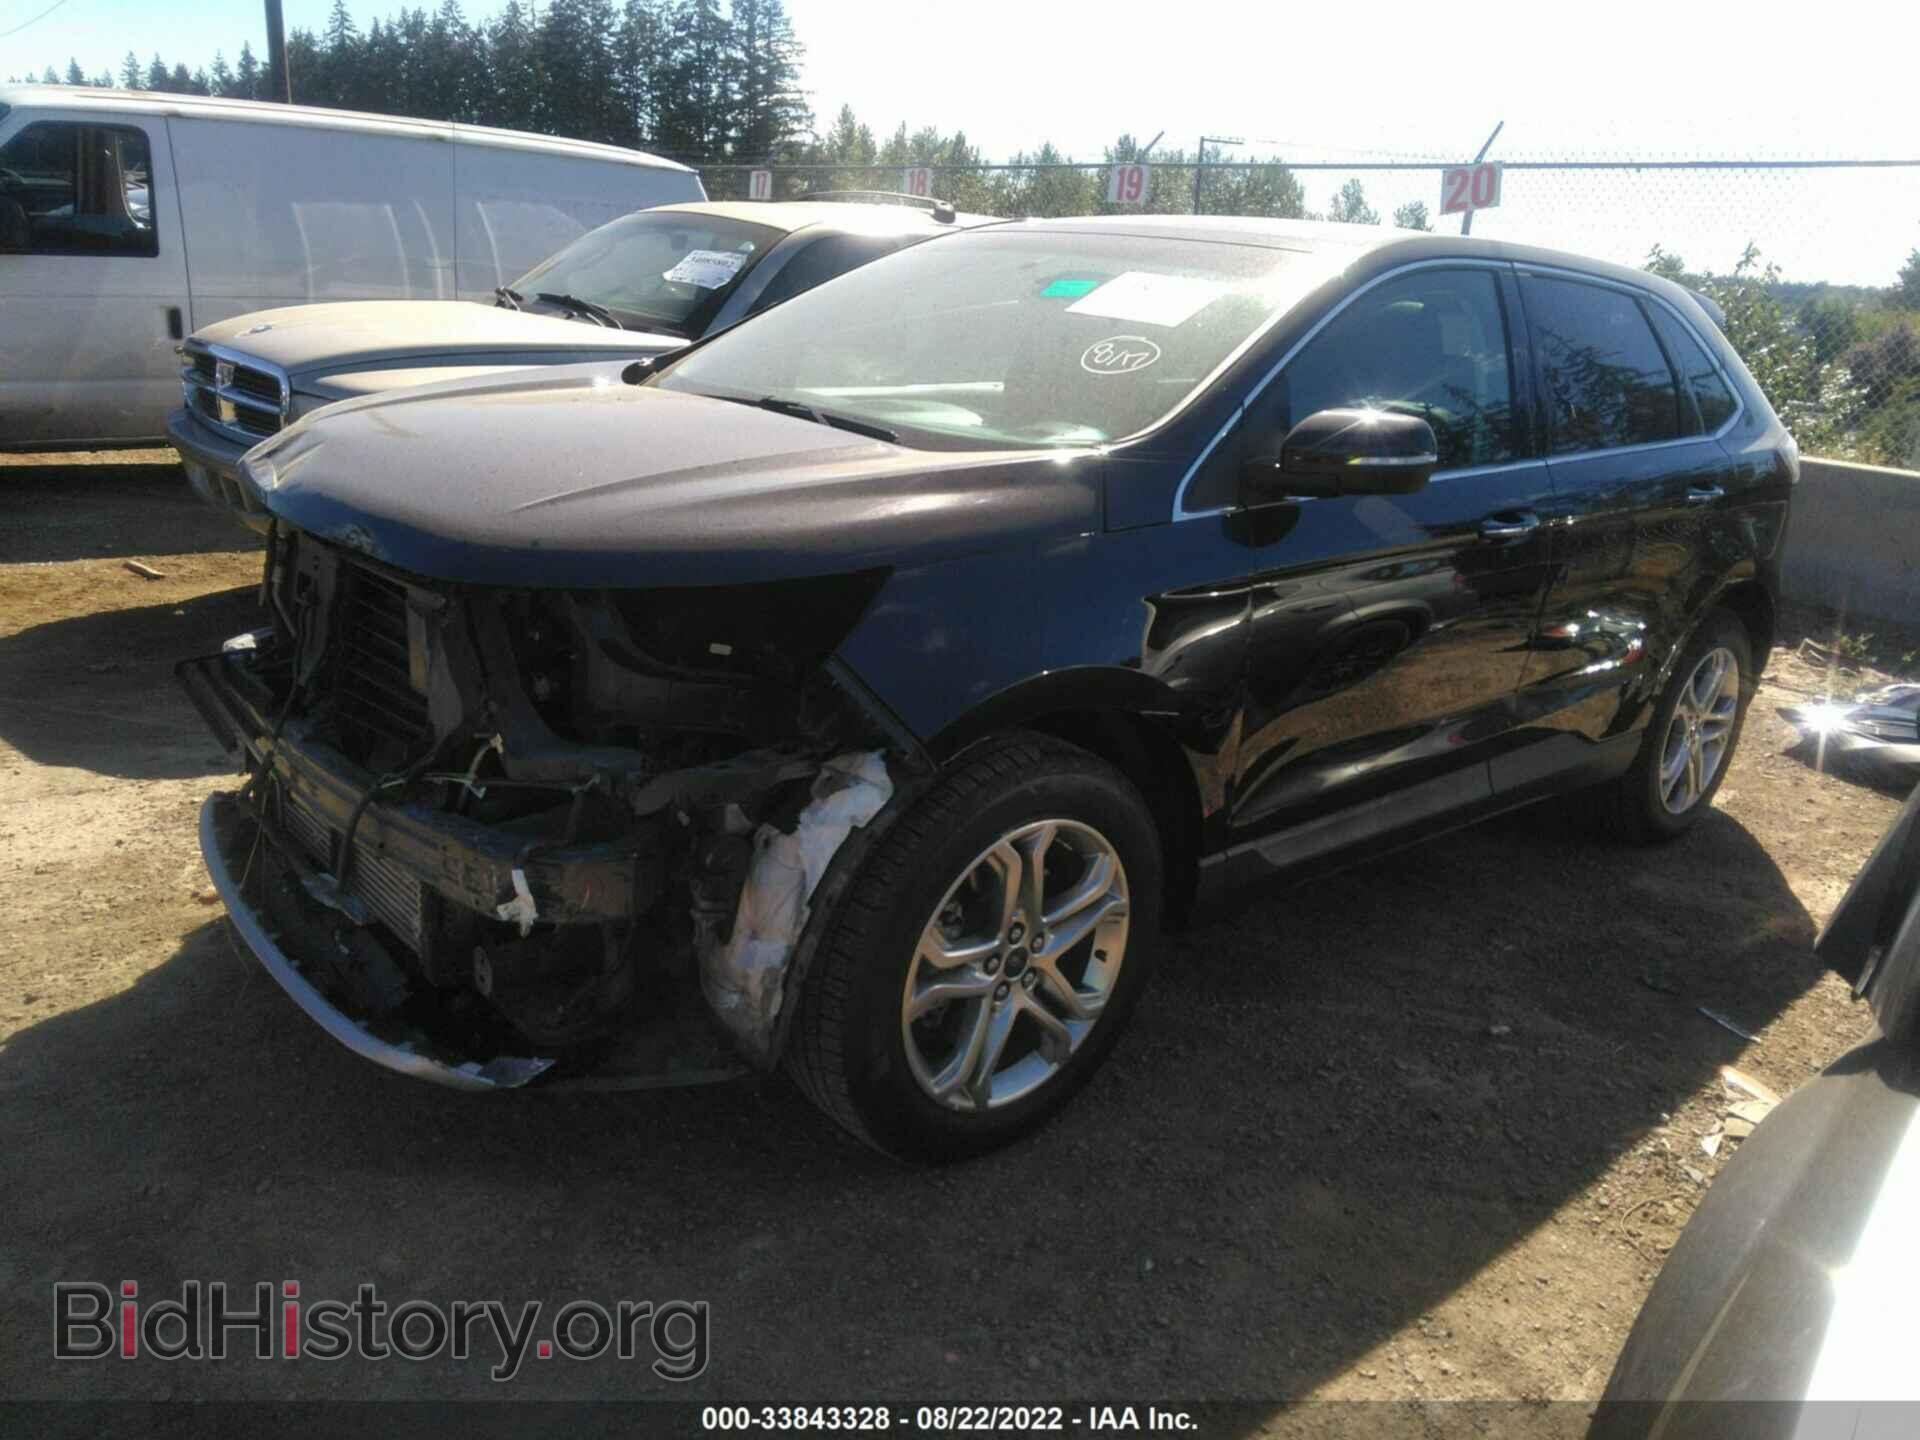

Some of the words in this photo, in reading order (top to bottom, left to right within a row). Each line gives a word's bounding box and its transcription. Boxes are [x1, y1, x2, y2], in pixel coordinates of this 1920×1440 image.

[755, 172, 768, 197] 17
[908, 168, 928, 196] 18
[1116, 165, 1143, 201] 19
[1445, 163, 1494, 210] 20
